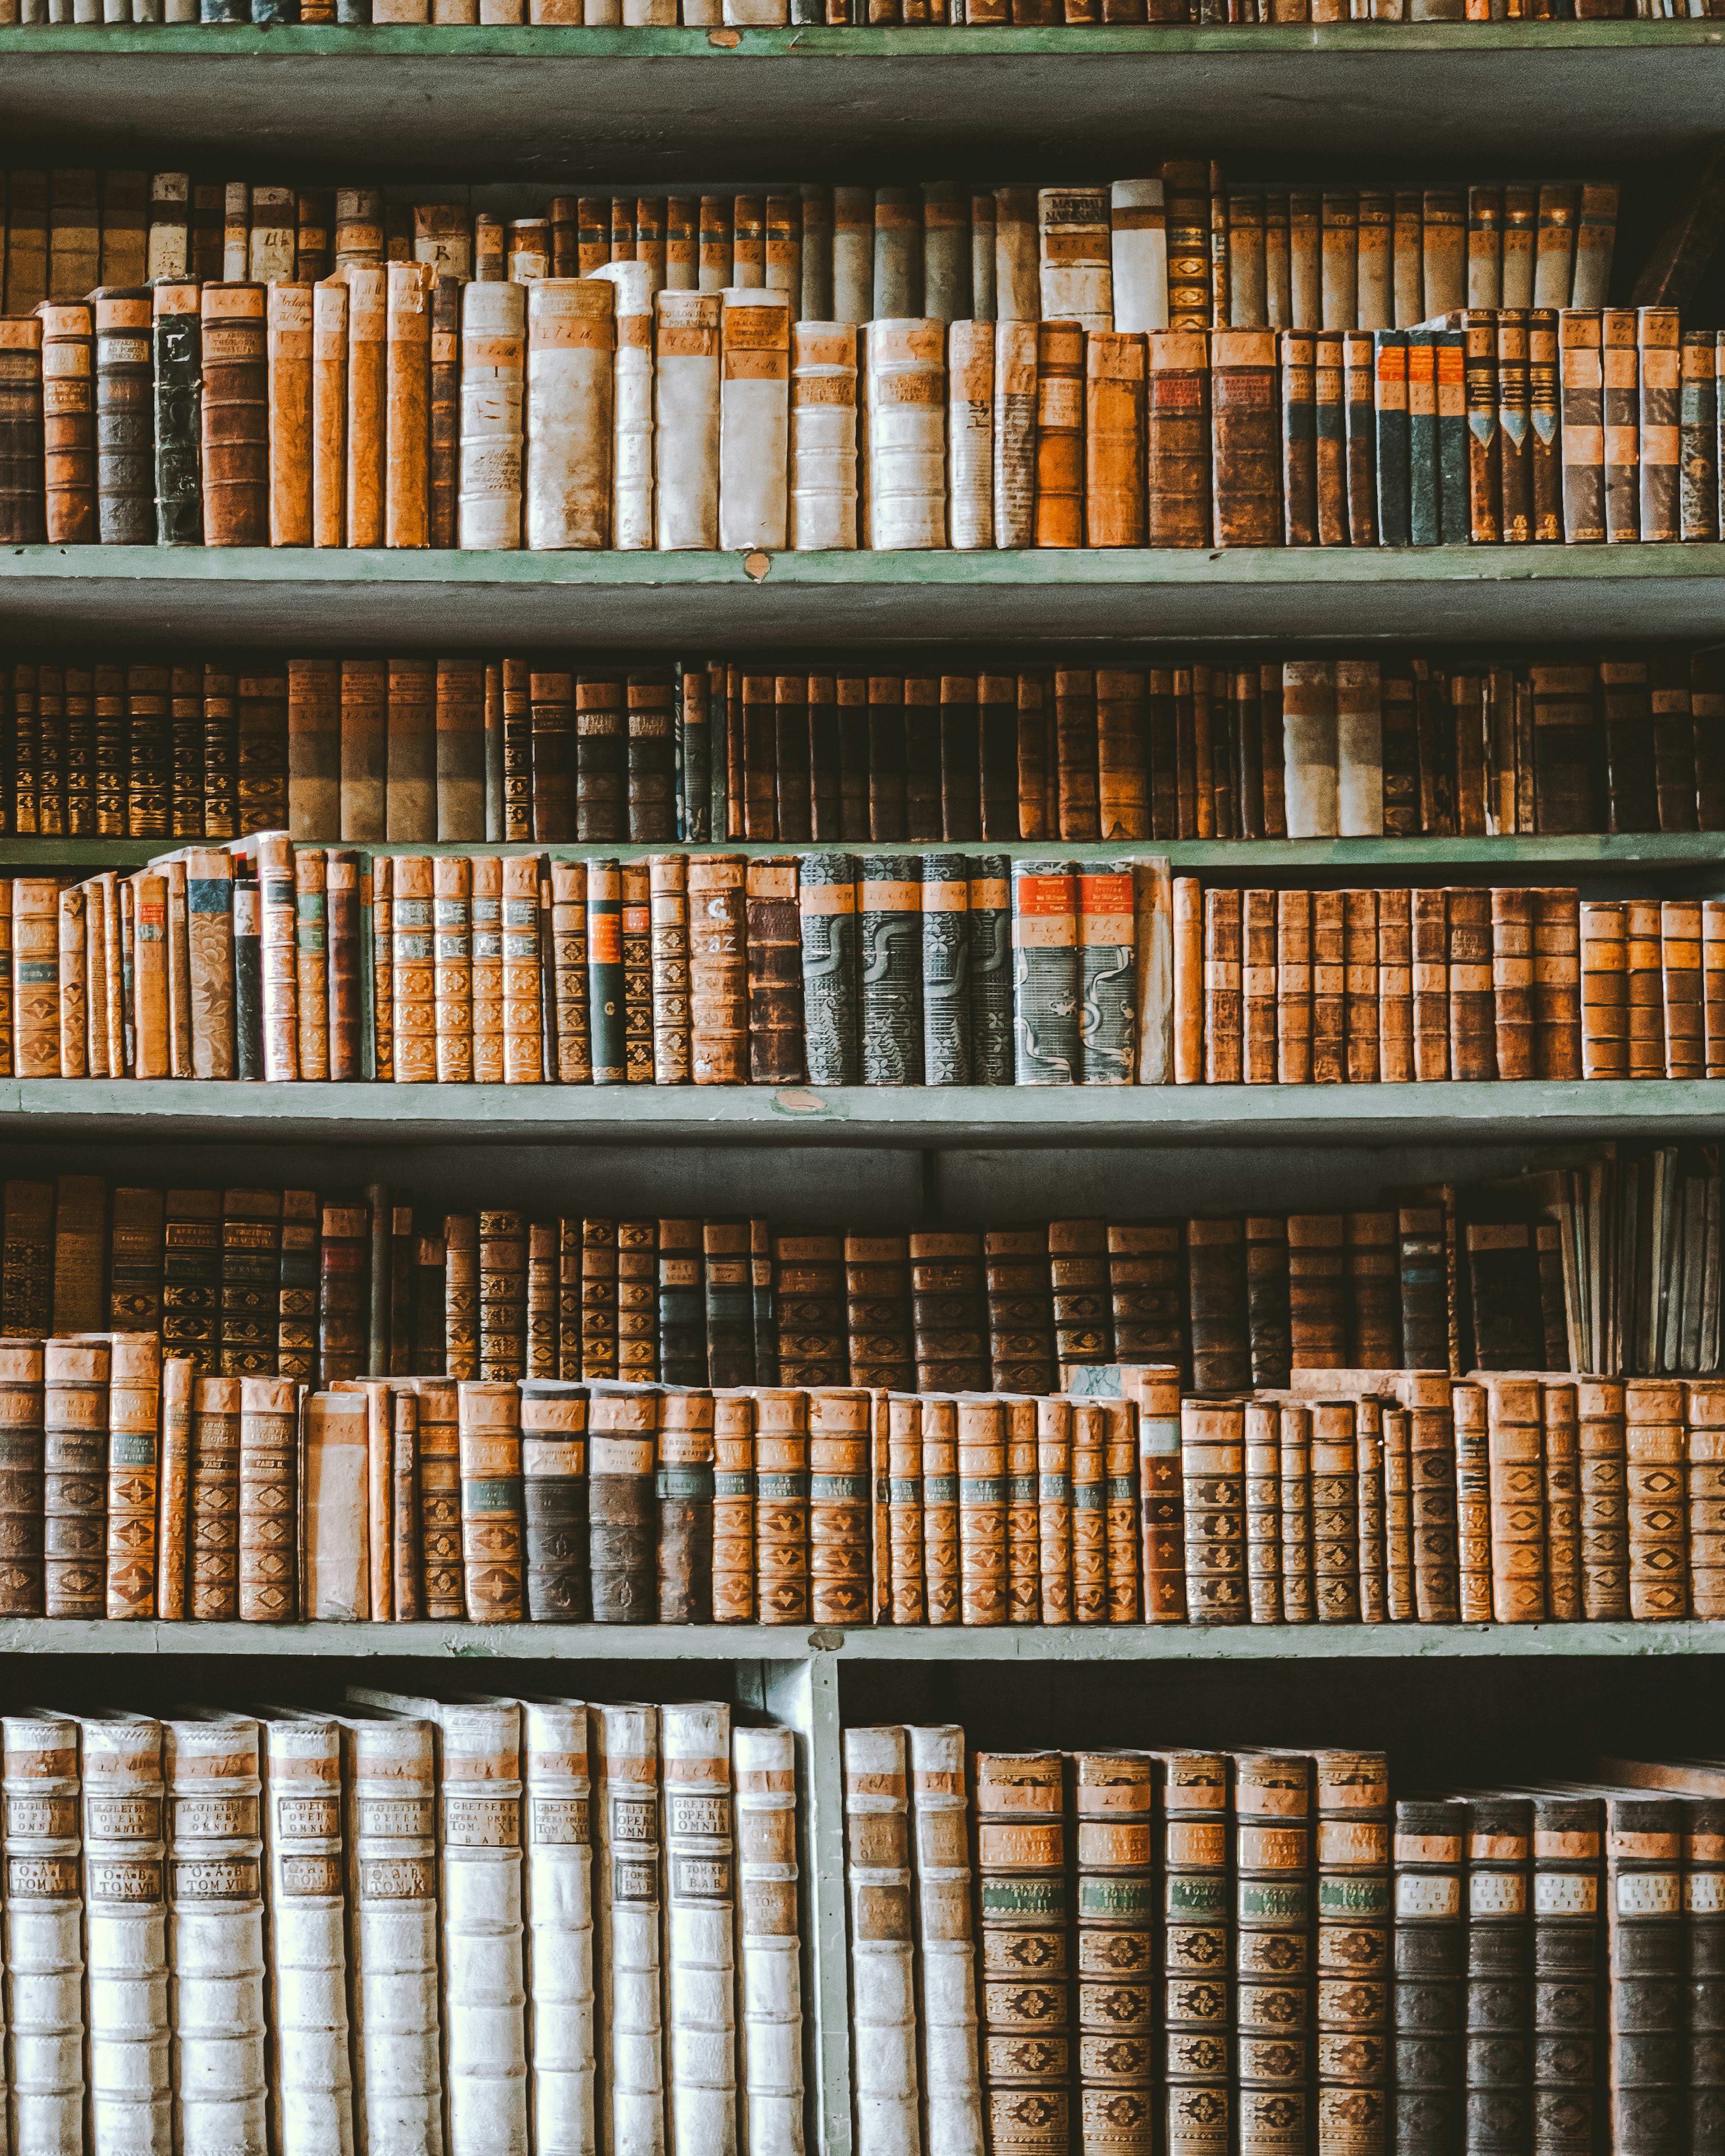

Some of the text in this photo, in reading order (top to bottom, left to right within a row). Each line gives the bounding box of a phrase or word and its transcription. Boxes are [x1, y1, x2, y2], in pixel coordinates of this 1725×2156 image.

[435, 245, 450, 261] R
[453, 1802, 516, 1811] GRETSERI
[674, 1800, 727, 1809] GRETSERI
[374, 1813, 420, 1822] OPERA
[449, 1813, 478, 1821] OPERA
[678, 1810, 724, 1820] OPERA
[289, 1823, 331, 1833] OMNIA
[374, 1823, 420, 1832] OMNIA
[678, 1820, 726, 1831] OMNIA
